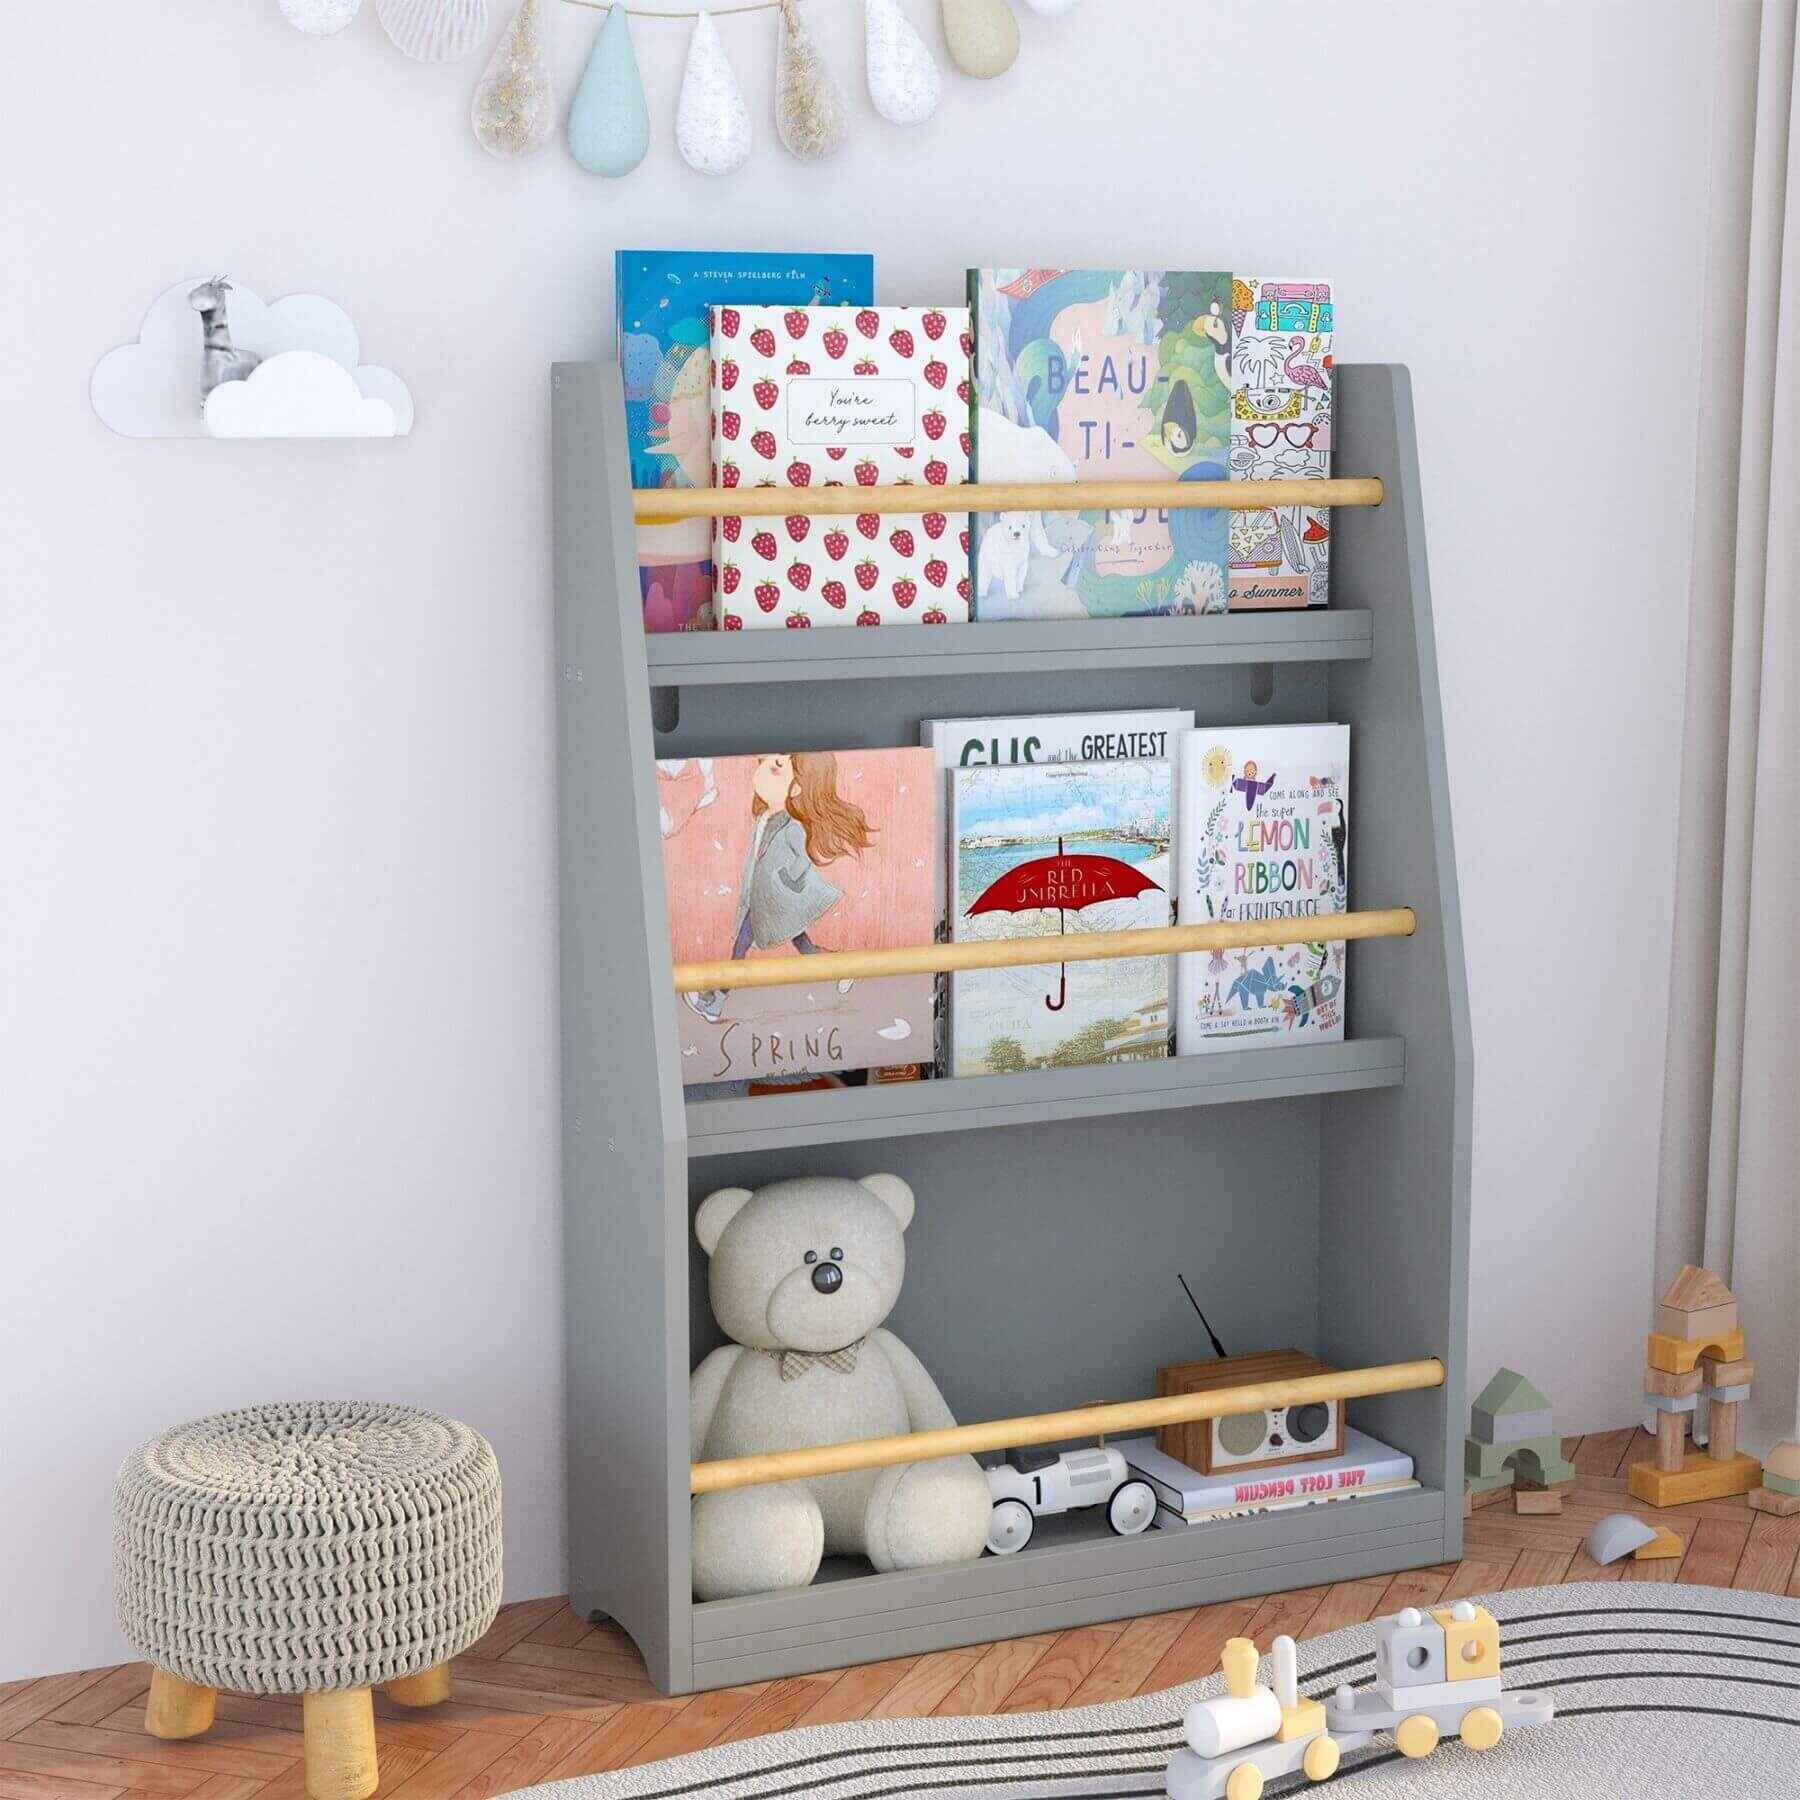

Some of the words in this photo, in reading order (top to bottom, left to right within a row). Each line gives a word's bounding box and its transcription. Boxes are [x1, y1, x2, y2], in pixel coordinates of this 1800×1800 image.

[703, 271, 733, 279] STEVEN
[737, 271, 781, 279] SPIELBERG
[785, 269, 806, 279] FILM
[830, 388, 874, 407] You're
[805, 412, 849, 433] berry
[852, 412, 897, 426] sweet
[1078, 420, 1135, 459] TI-
[1243, 584, 1305, 599] Summer
[1081, 731, 1168, 760] GREATEST
[1235, 818, 1310, 852] LEMON
[1047, 868, 1083, 885] RED
[1234, 858, 1313, 895] RIBBON
[713, 1023, 842, 1077] SPRING
[1033, 1476, 1042, 1505] 1
